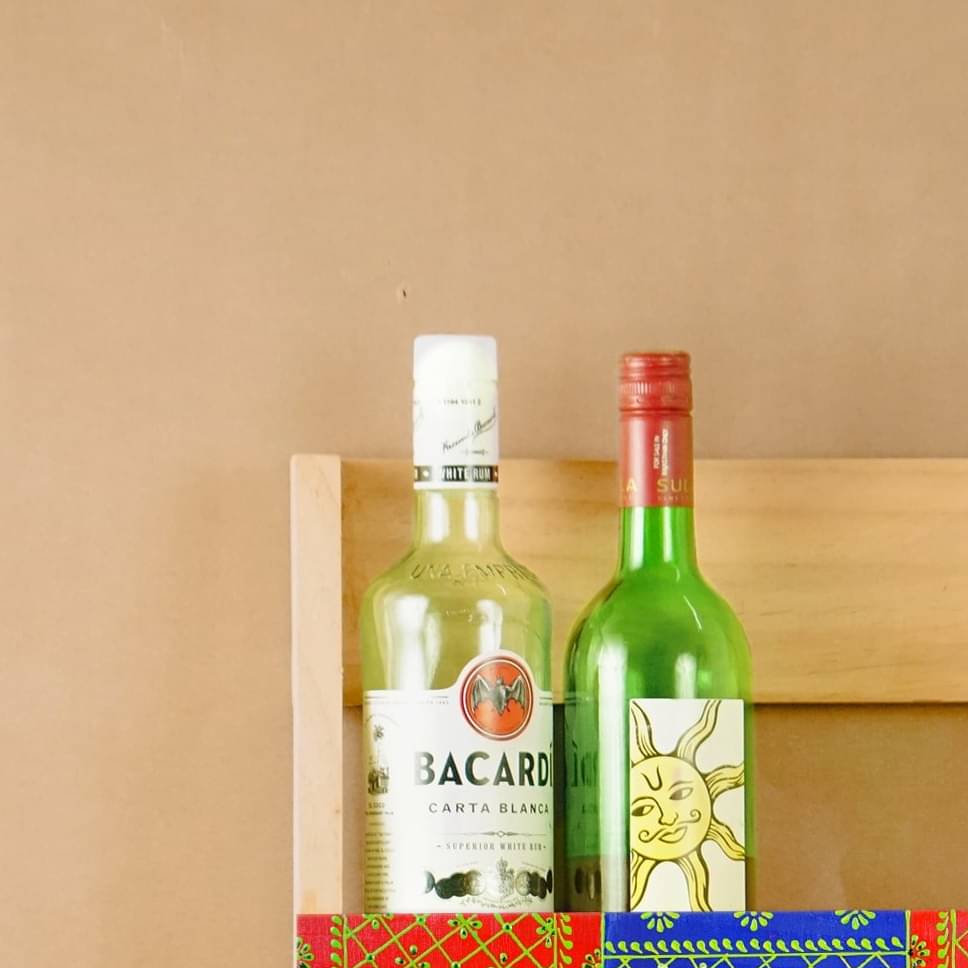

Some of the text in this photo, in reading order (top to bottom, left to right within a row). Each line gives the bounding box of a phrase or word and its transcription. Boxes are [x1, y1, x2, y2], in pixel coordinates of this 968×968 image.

[473, 466, 491, 480] RUM
[429, 803, 548, 813] CARTA BLANCA
[446, 842, 495, 850] SUPERIOR
[500, 842, 526, 850] WHITE
